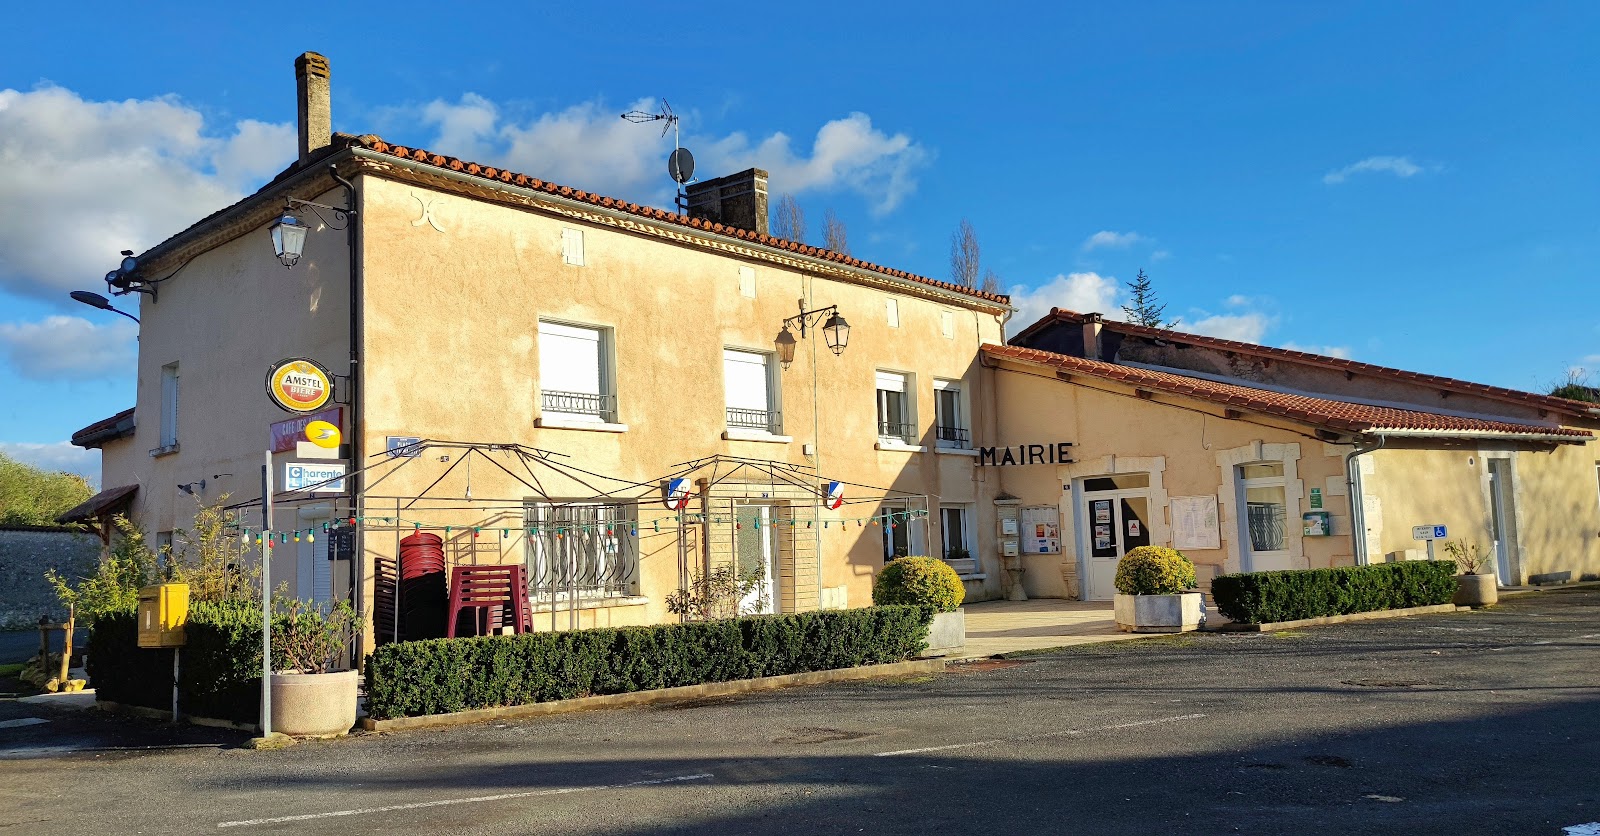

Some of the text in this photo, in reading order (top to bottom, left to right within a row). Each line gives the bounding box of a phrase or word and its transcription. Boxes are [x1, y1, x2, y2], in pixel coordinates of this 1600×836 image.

[285, 375, 322, 389] AMSTEL
[980, 443, 1073, 467] MAIRIE
[291, 467, 342, 478] Charente
